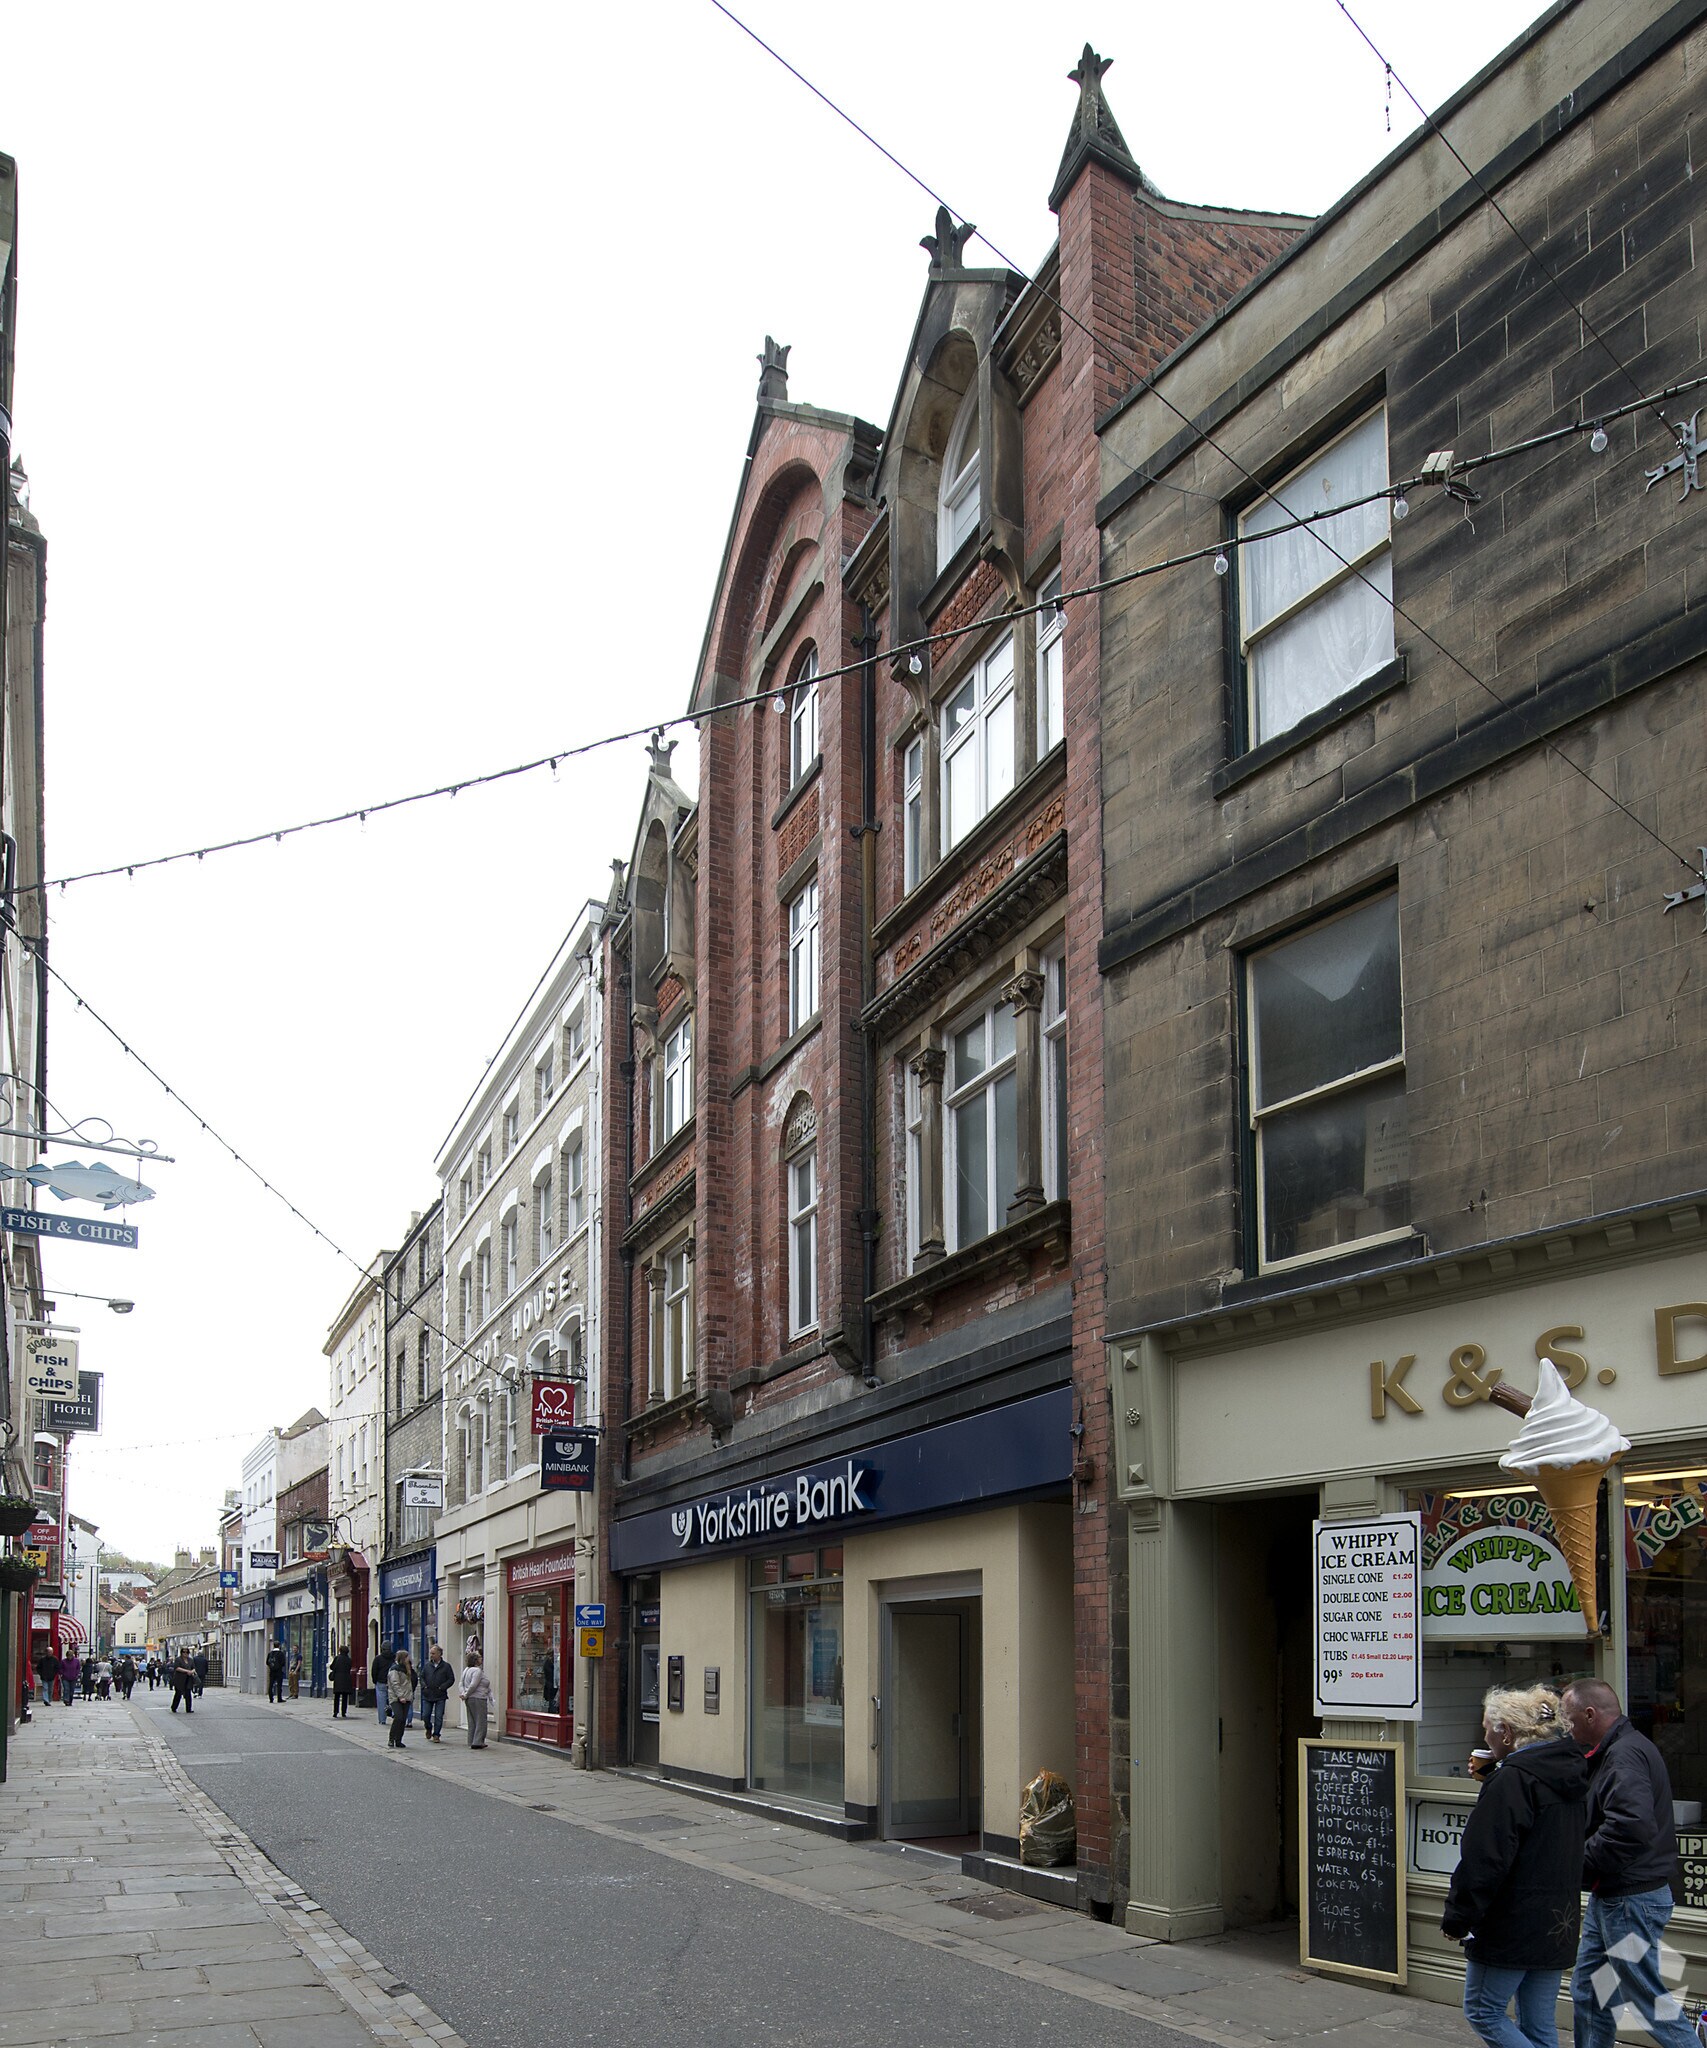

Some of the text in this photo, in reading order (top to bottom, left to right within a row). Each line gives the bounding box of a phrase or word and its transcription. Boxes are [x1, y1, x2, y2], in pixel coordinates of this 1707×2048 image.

[7, 1213, 133, 1244] FISH & CHIPS
[35, 1355, 68, 1366] FISH
[455, 1330, 501, 1394] TALBOT
[45, 1367, 56, 1377] &
[28, 1377, 73, 1389] CHIPS
[54, 1404, 93, 1416] HOTEL
[546, 1463, 590, 1473] MINIBANK
[697, 1460, 864, 1544] Yorkshire Bank
[1459, 1503, 1483, 1528] &
[1635, 1495, 1703, 1555] ICE
[1331, 1532, 1399, 1549] WHIPPY
[1321, 1550, 1414, 1569] ICE CREAM
[1447, 1536, 1552, 1573] WHIPPY
[512, 1564, 529, 1581] British
[529, 1561, 544, 1576] Heart
[1323, 1574, 1355, 1585] SINGLE
[1357, 1572, 1383, 1583] CONE
[1323, 1592, 1360, 1603] DOUBLE
[1362, 1591, 1388, 1602] CONE
[1421, 1581, 1580, 1617] ICE CREAM
[1323, 1612, 1354, 1622] SUGAR
[1356, 1611, 1382, 1621] CONE
[1323, 1632, 1348, 1642] CHOC
[1350, 1631, 1388, 1641] WAFFLE
[1323, 1651, 1347, 1661] TUBS
[1318, 1751, 1387, 1766] TAKE AWAY
[1311, 1769, 1338, 1781] TEA
[1315, 1783, 1354, 1795] COFFEE
[1316, 1793, 1351, 1805] LATTE
[1316, 1804, 1378, 1817] CAPPUCCINO
[1318, 1816, 1342, 1829] HOT
[1421, 1829, 1463, 1845] HOT
[1318, 1847, 1366, 1861] ESPRESSO
[1316, 1863, 1350, 1876] WATER
[1317, 1878, 1345, 1889] COKE
[1318, 1902, 1360, 1918] GLOVES
[1323, 1920, 1363, 1937] HATS
